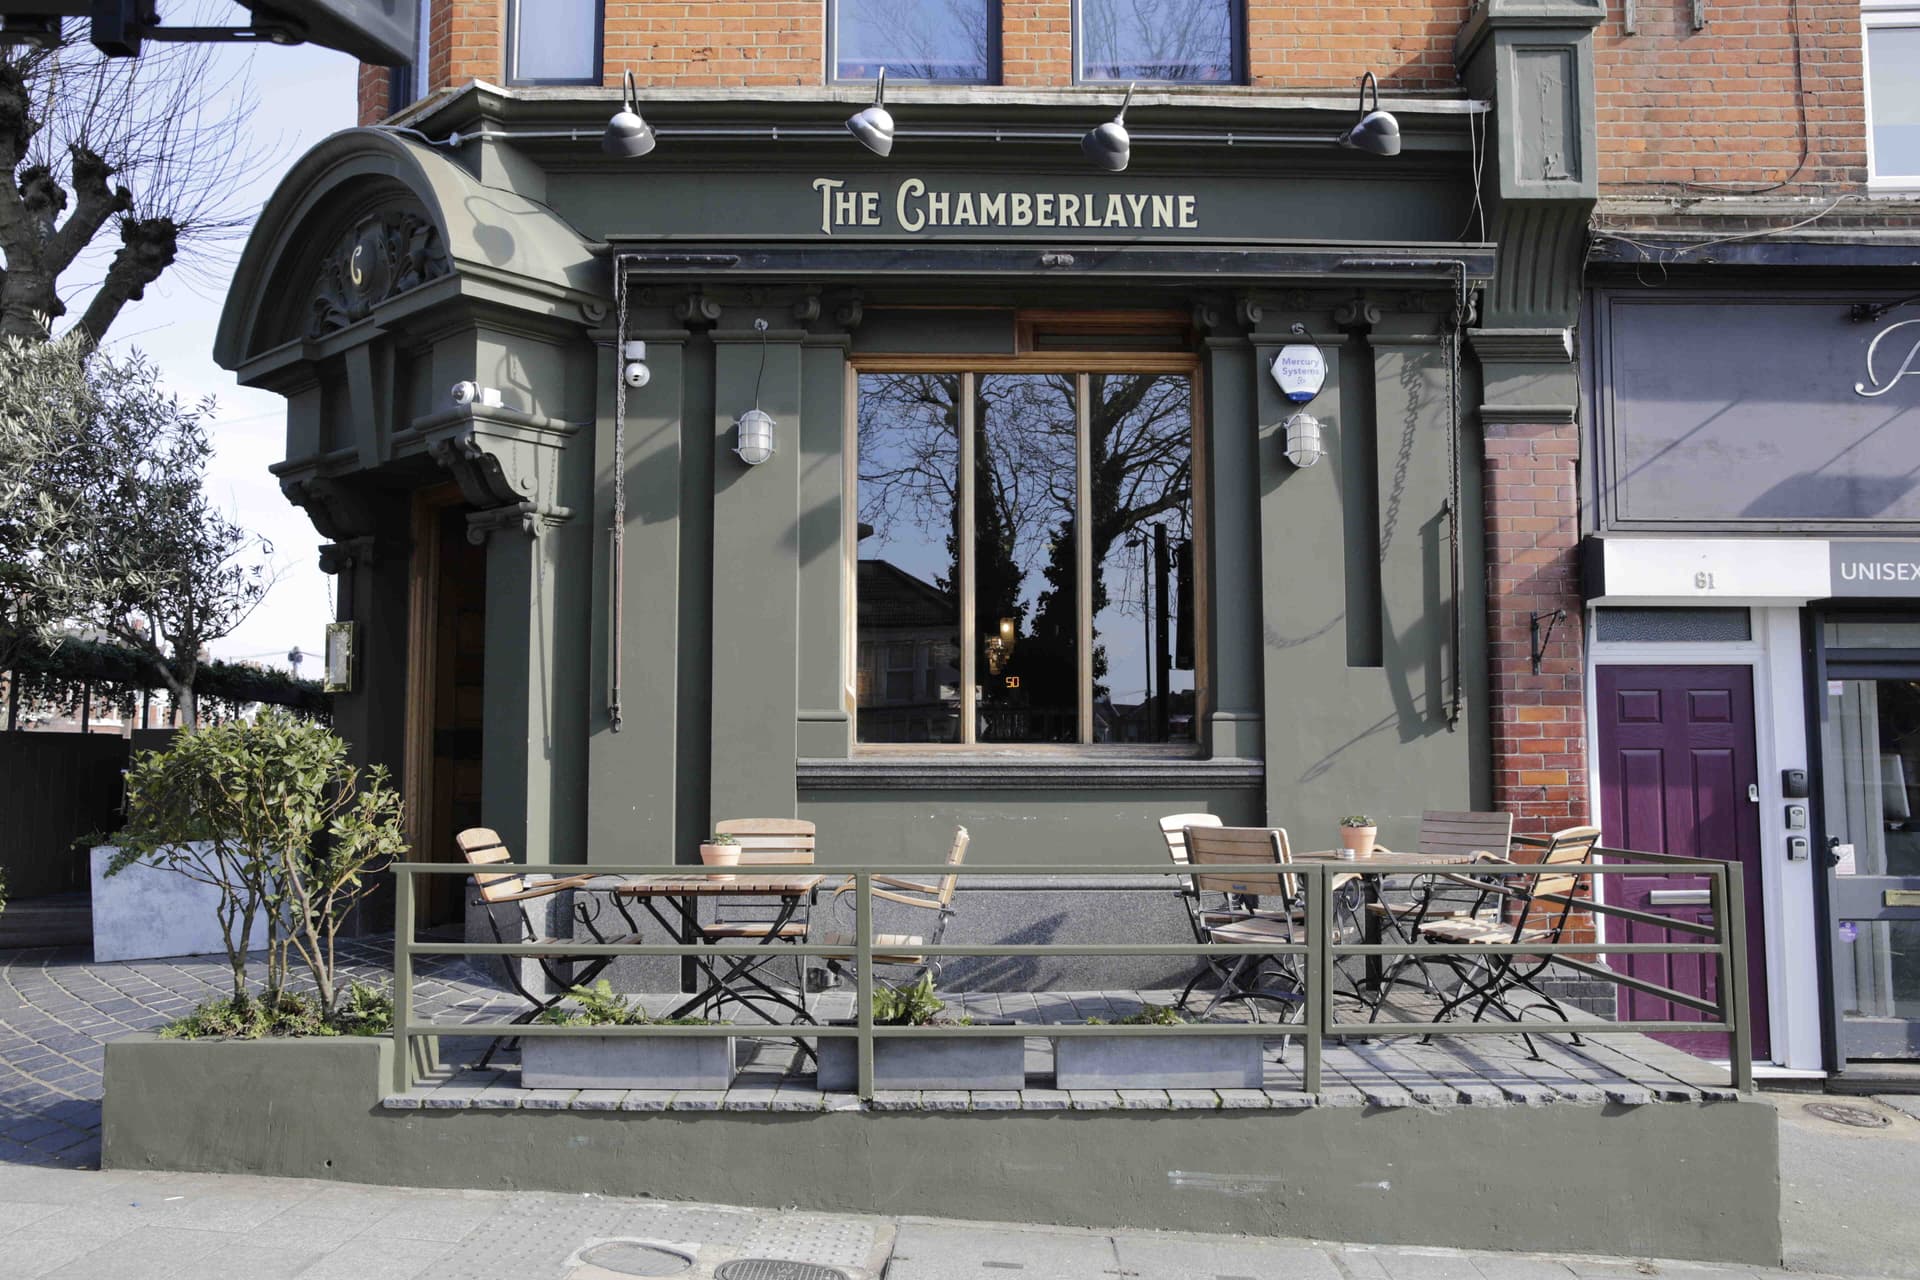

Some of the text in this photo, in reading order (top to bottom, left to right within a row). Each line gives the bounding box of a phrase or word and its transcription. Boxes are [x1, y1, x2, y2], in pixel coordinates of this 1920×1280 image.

[1281, 358, 1320, 368] Mercury
[1282, 367, 1320, 377] Systems
[1841, 562, 1920, 581] UNISEX
